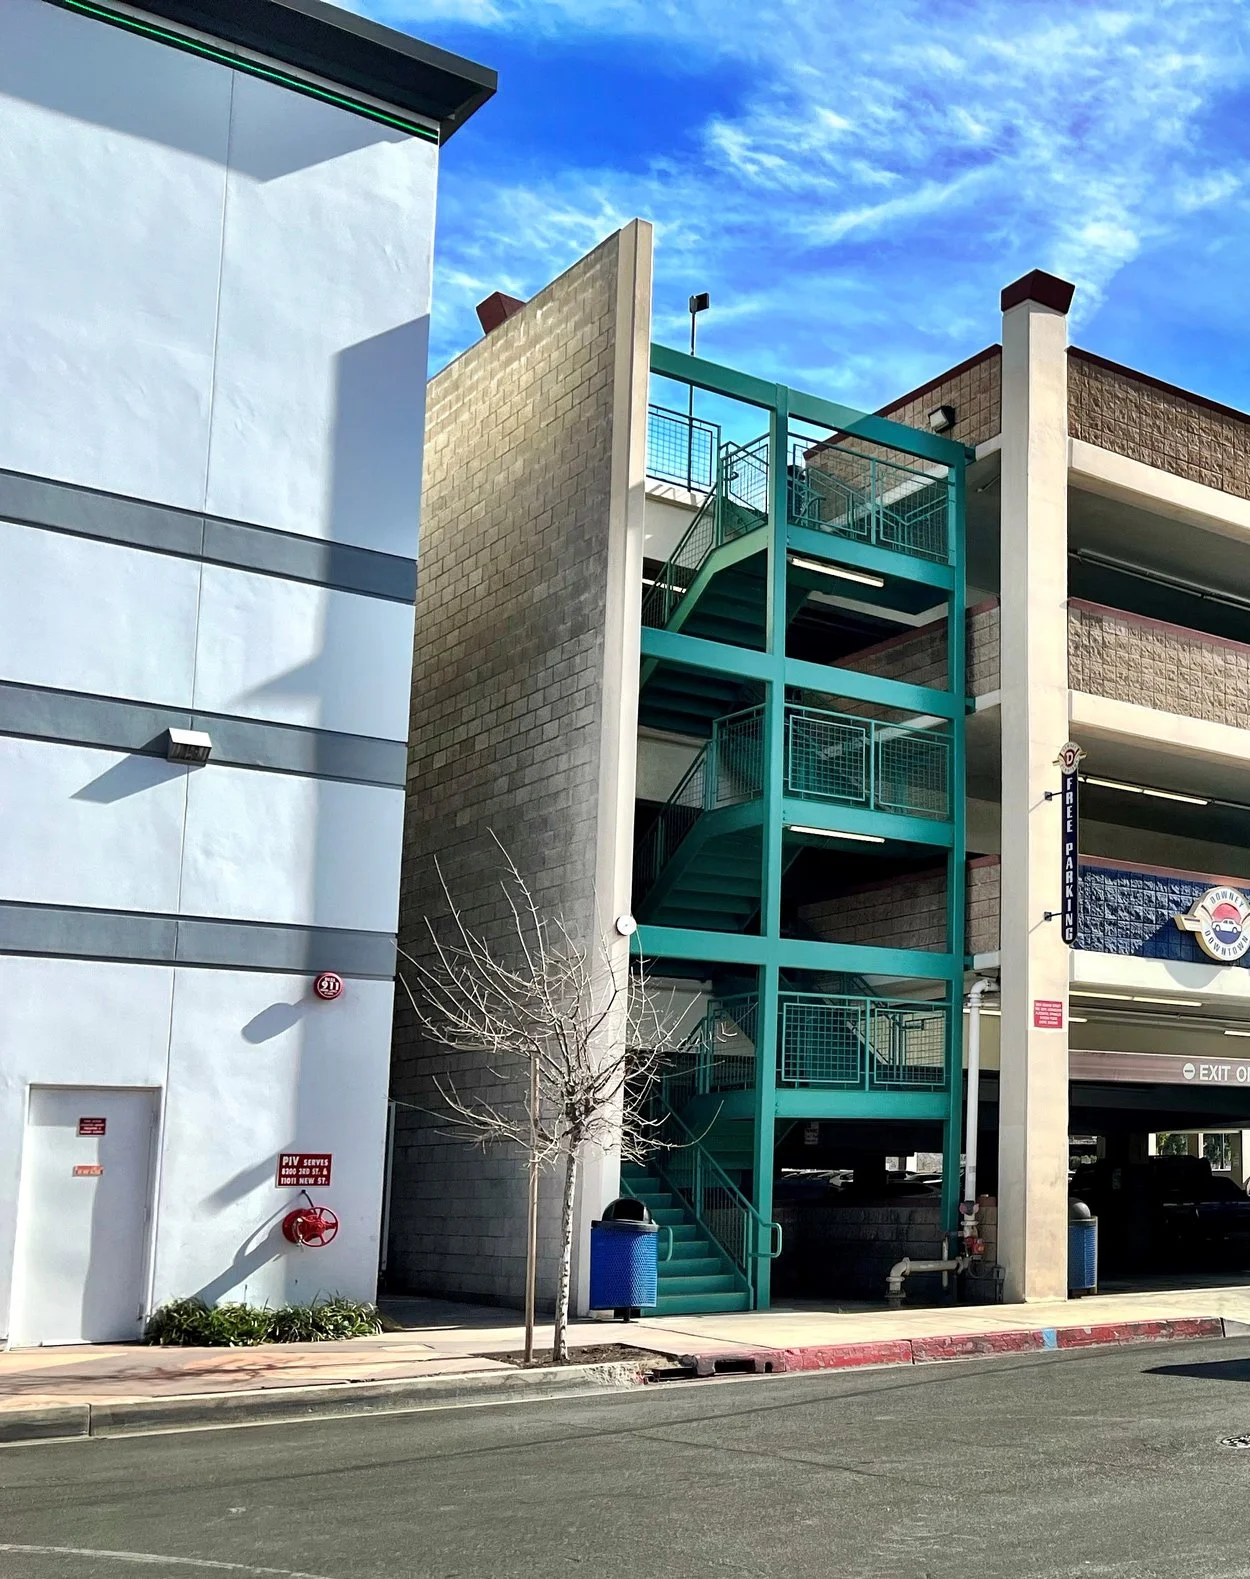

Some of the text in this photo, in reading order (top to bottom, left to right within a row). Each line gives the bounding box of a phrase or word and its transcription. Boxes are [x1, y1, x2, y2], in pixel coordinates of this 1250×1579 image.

[1065, 777, 1074, 833] FREE
[1065, 842, 1074, 941] PARKING
[1210, 890, 1244, 908] DOWNEY
[1205, 930, 1248, 956] DOWNTOWN
[321, 980, 340, 991] 911
[1199, 1064, 1231, 1082] EXIT
[282, 1156, 329, 1167] PIV SERVES
[312, 1167, 321, 1175] ST.
[322, 1167, 328, 1175] &
[299, 1177, 315, 1185] NEW
[317, 1177, 328, 1185] ST.
